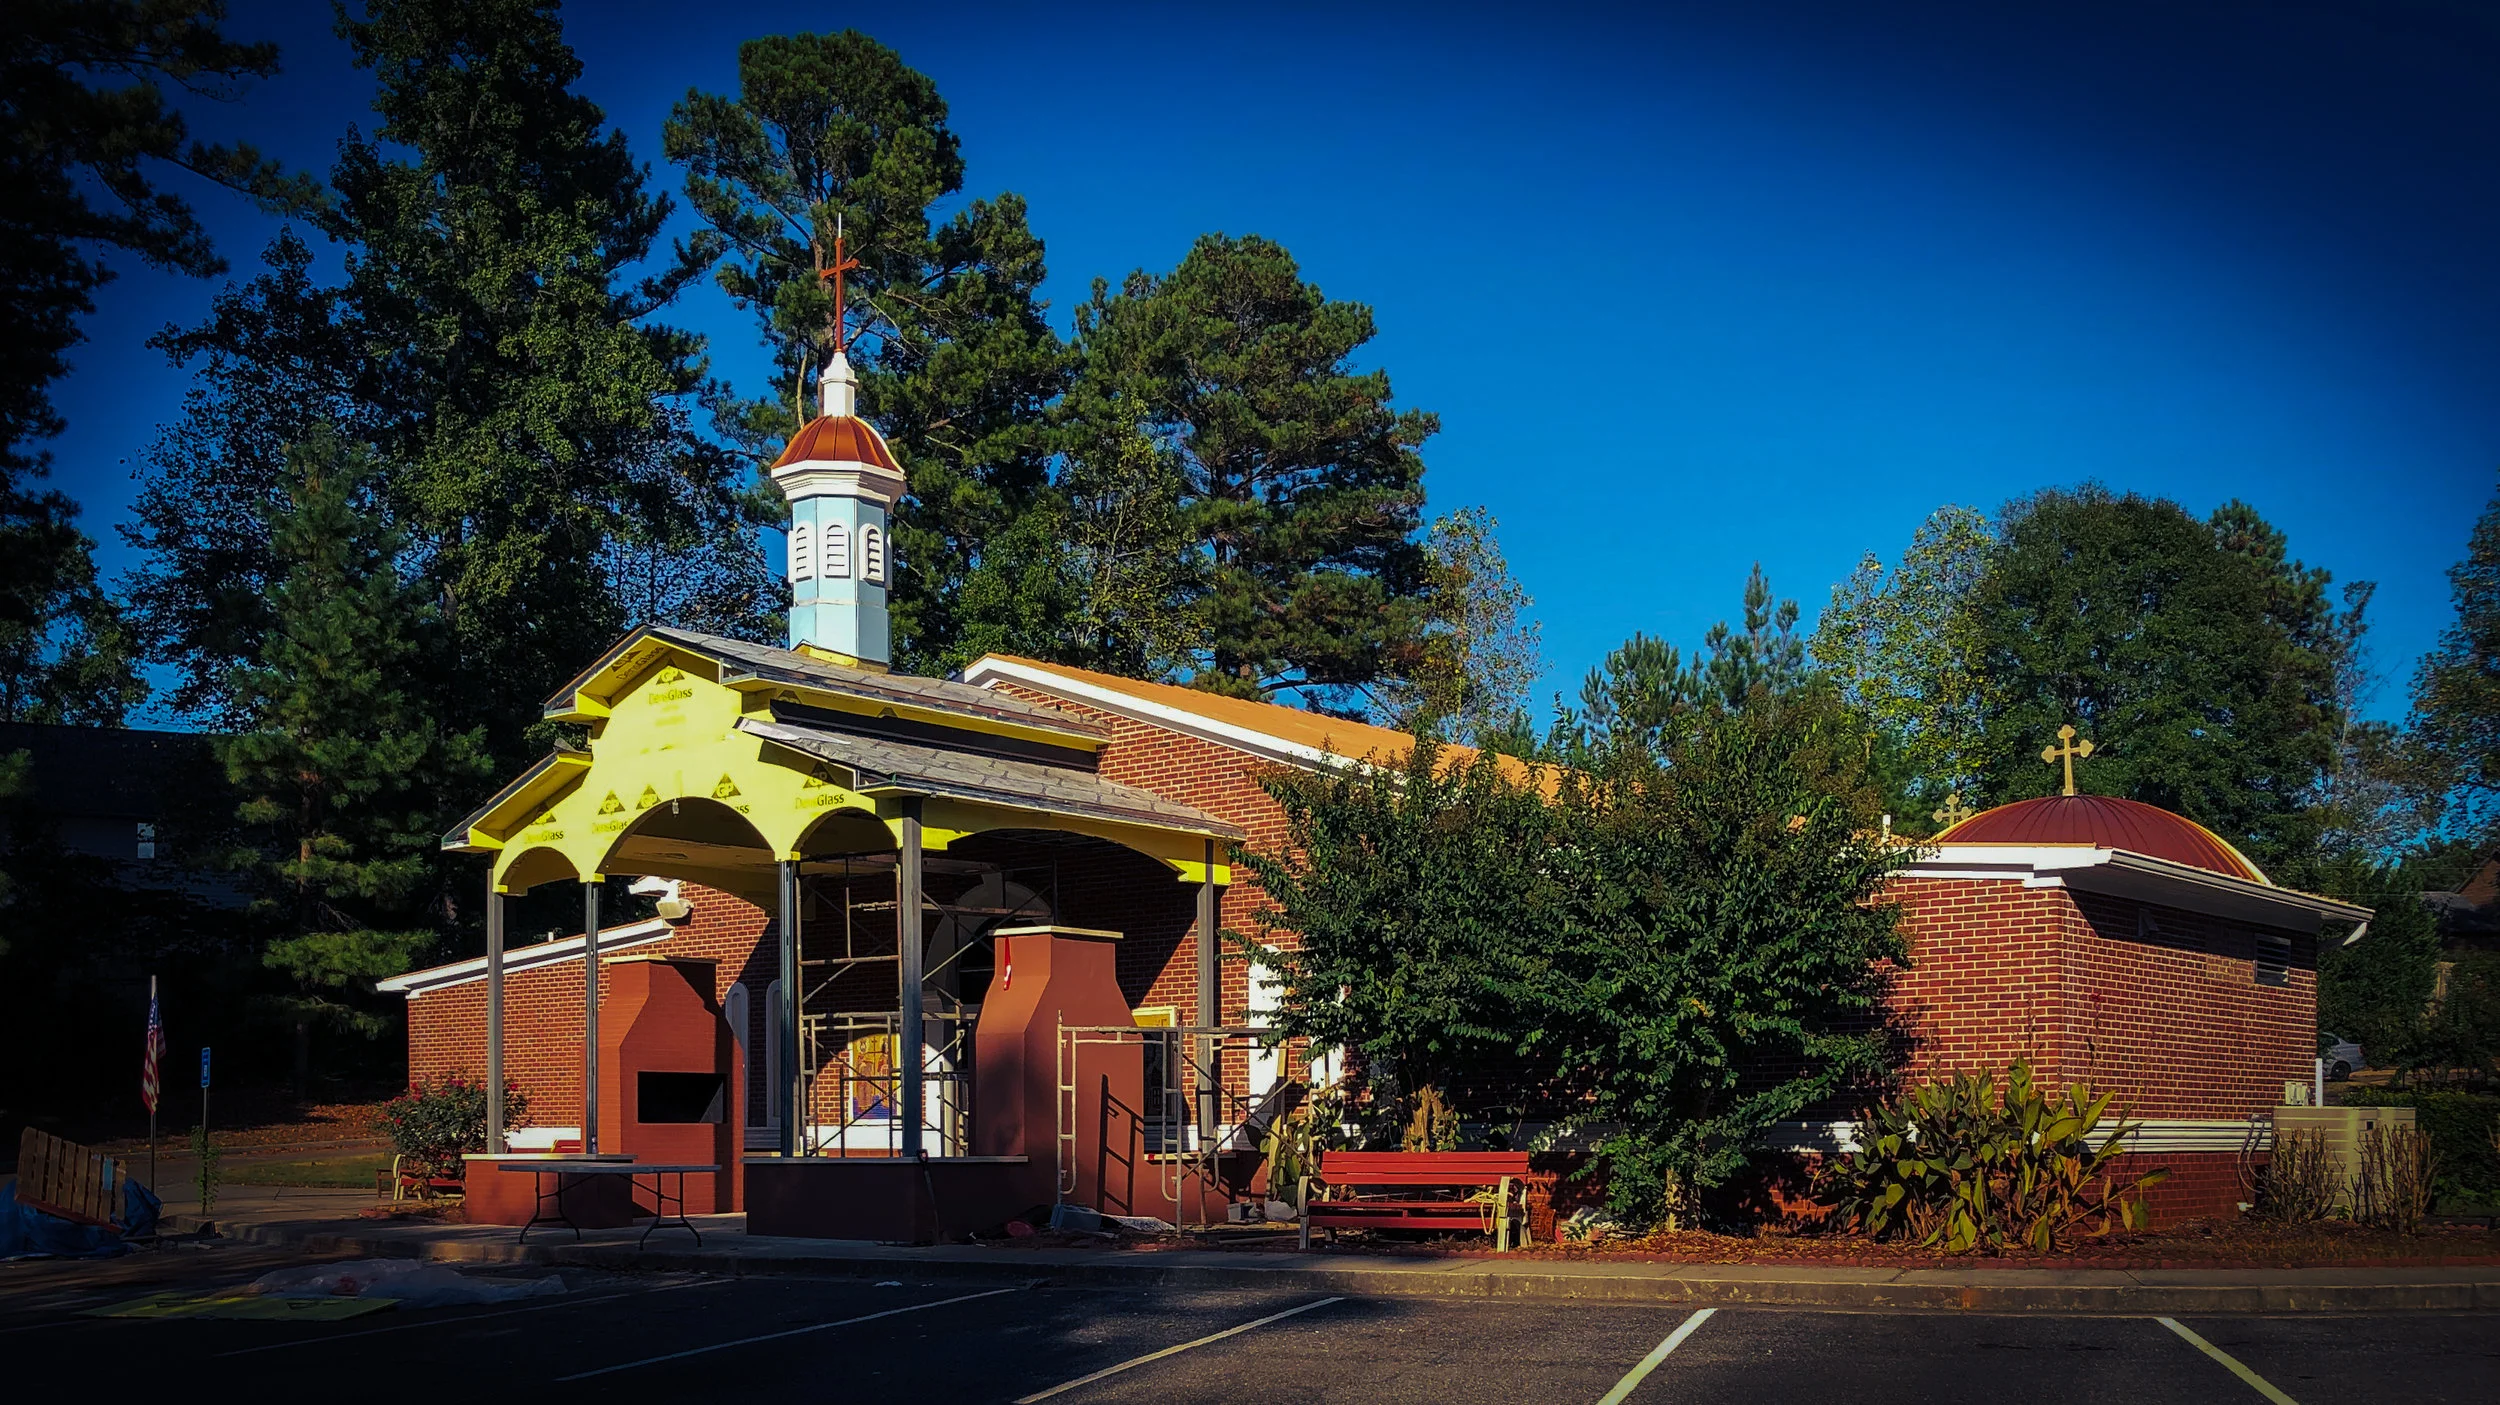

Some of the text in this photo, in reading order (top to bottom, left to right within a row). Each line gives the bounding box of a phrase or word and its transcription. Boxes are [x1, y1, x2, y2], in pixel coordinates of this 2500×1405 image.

[649, 688, 693, 704] DensGlass
[717, 782, 734, 797] GP
[603, 799, 620, 813] GP
[795, 794, 845, 809] DensGlass
